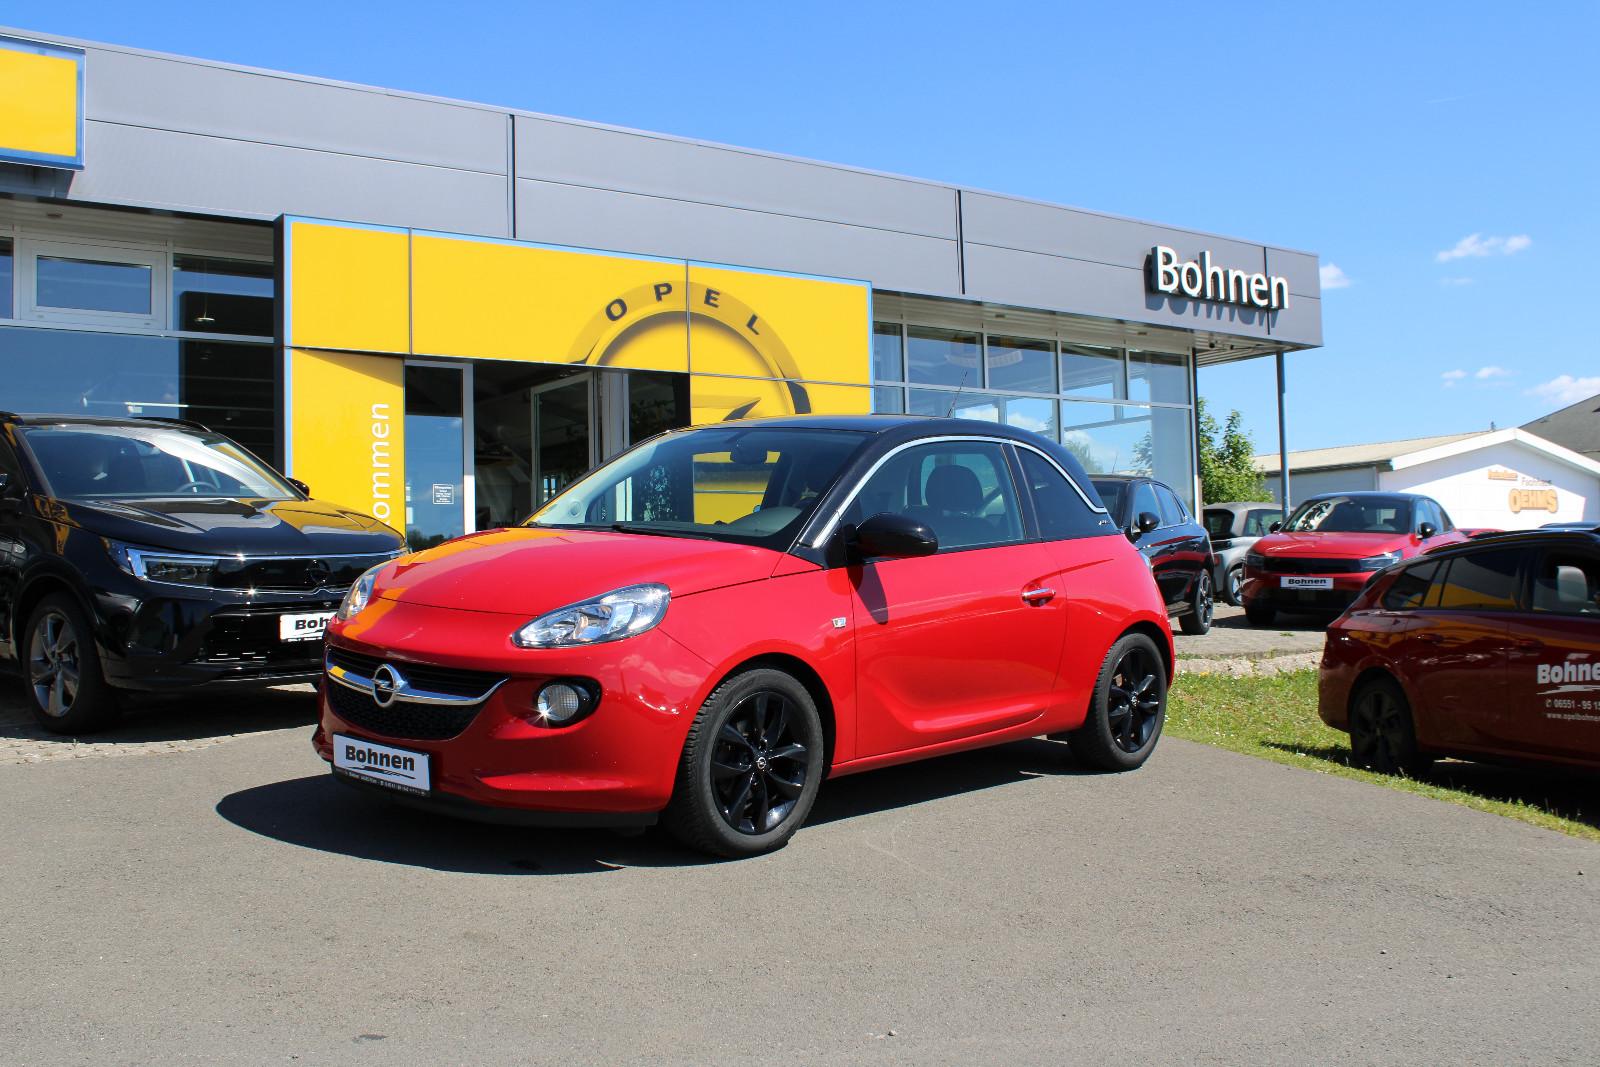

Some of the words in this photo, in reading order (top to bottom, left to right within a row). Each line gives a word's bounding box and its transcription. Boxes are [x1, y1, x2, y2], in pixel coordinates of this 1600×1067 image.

[1152, 245, 1289, 310] Bohnen
[605, 282, 760, 336] OPEL
[371, 403, 391, 525] ommen
[345, 745, 415, 771] Bohnen
